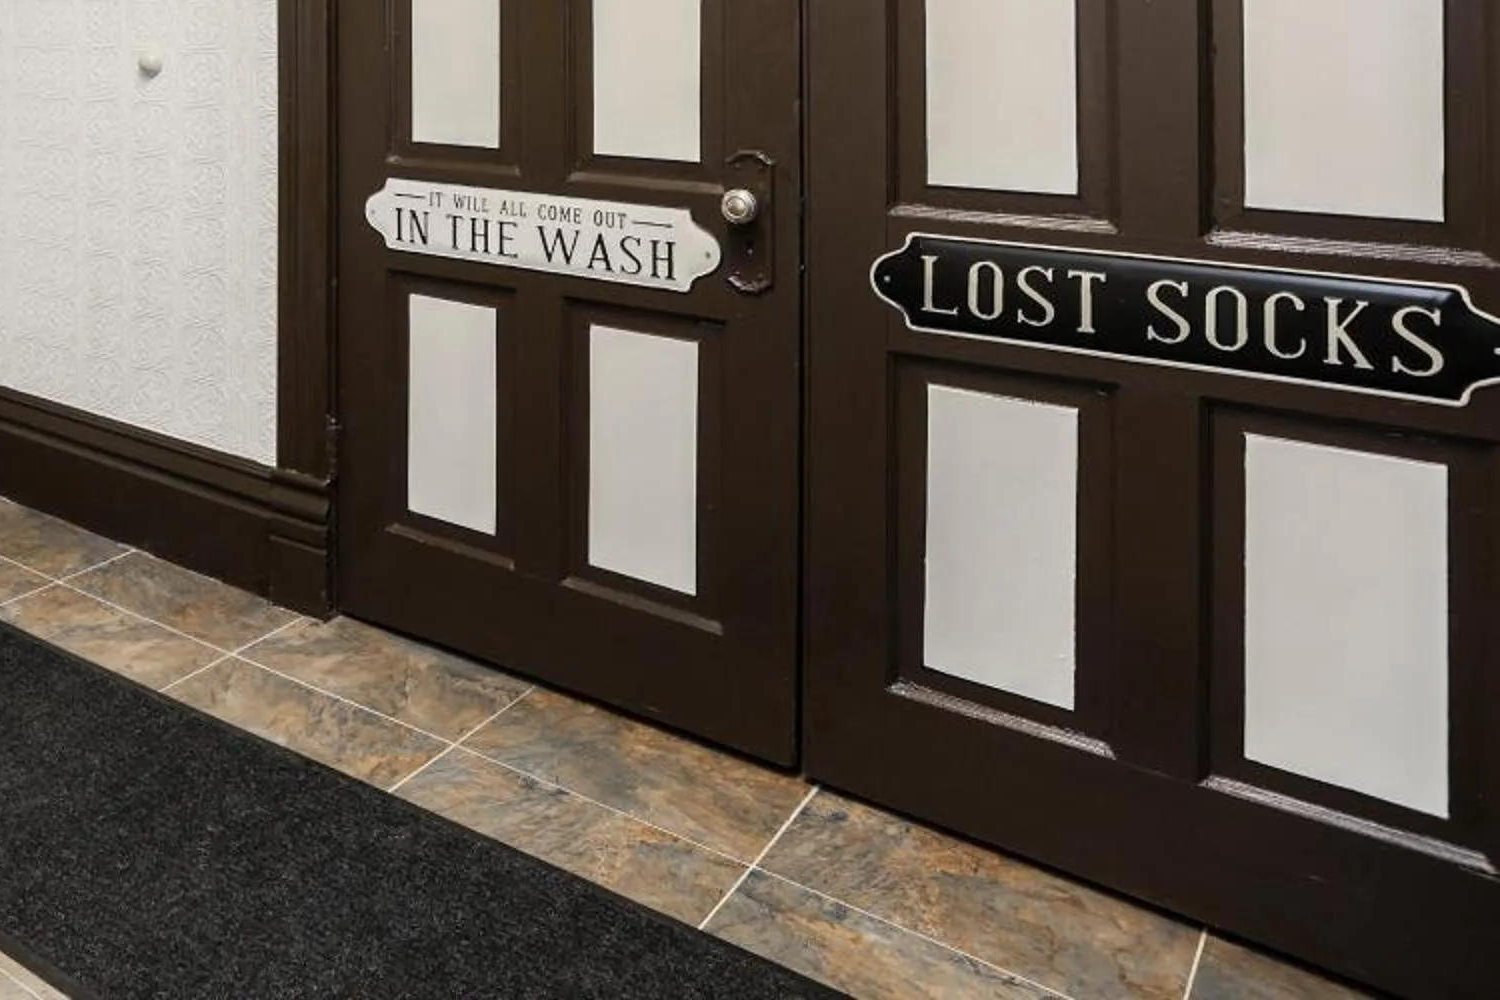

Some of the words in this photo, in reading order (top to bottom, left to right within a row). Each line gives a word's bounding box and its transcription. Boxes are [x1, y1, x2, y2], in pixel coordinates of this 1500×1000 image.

[394, 207, 430, 246] IN
[445, 213, 520, 260] THE
[536, 225, 677, 281] WASH
[428, 191, 443, 208] IT
[452, 194, 490, 214] WILL
[499, 199, 528, 218] ALL
[537, 203, 583, 225] COME
[592, 209, 628, 229] OUT
[919, 254, 1107, 335] LOST
[1145, 279, 1445, 378] SOCKS
